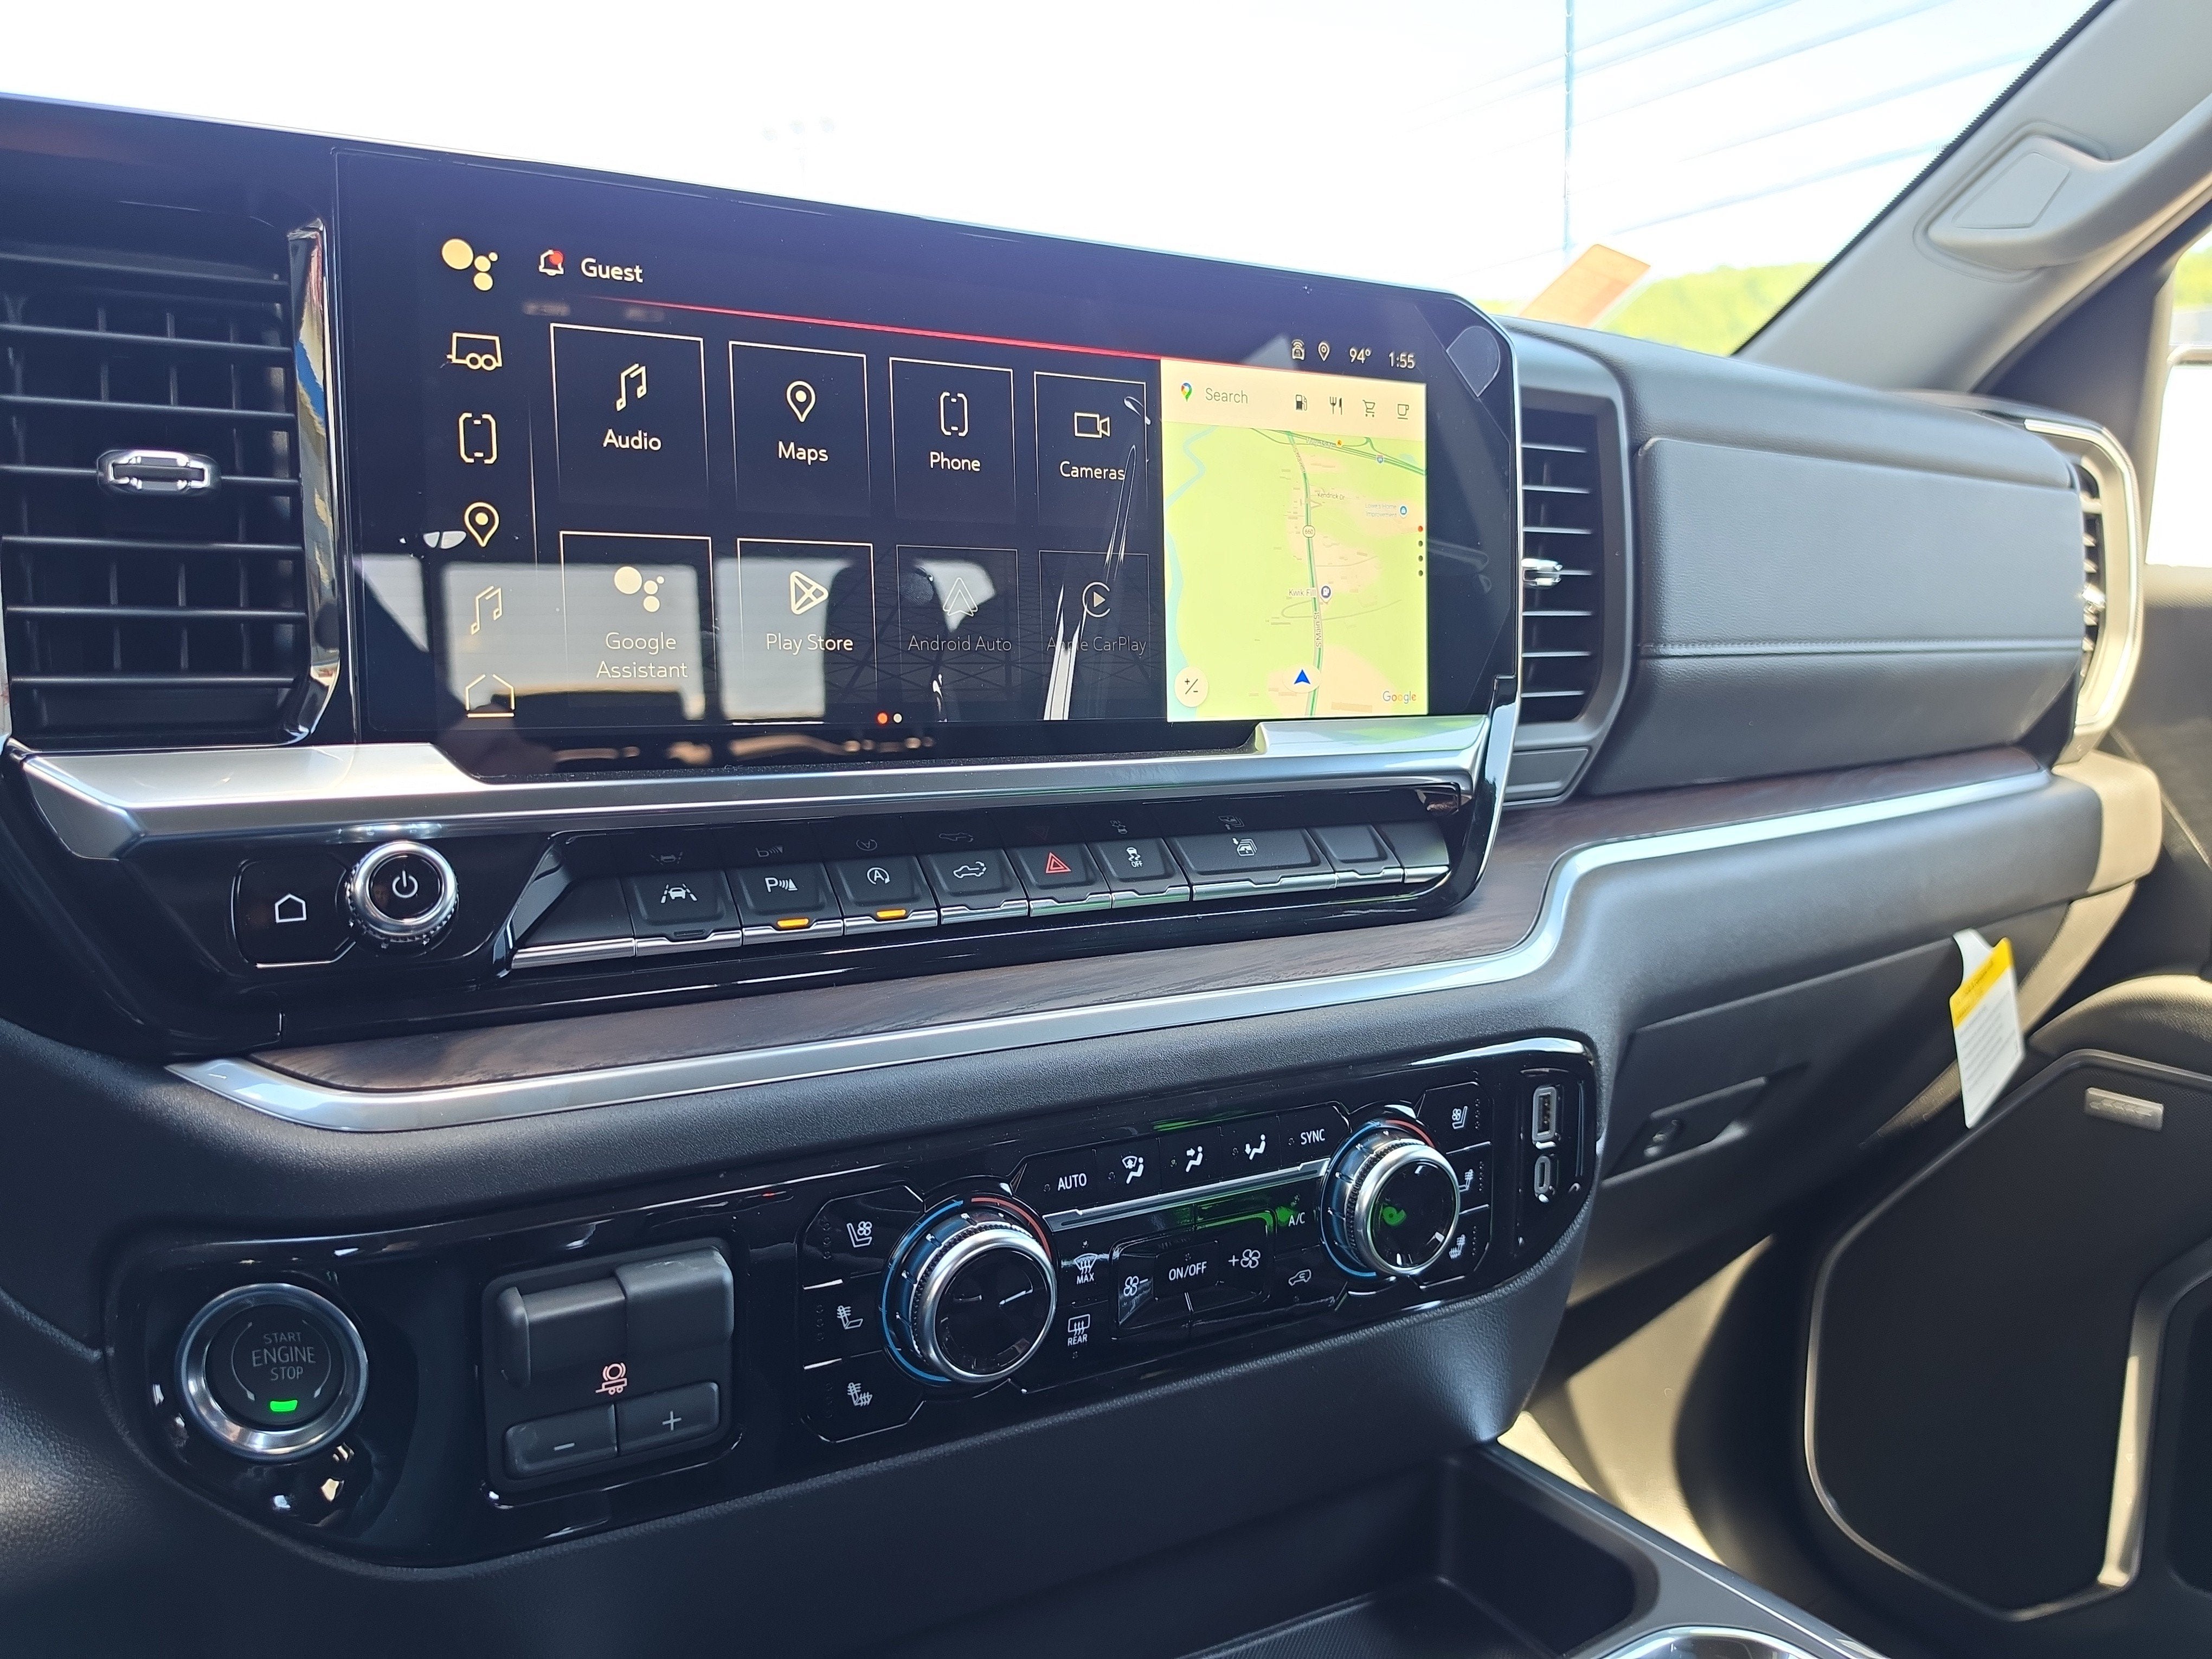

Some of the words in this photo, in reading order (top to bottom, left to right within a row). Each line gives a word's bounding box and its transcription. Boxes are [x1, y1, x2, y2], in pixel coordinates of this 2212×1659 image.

[580, 258, 644, 283] Guest
[1388, 351, 1416, 369] 1:55
[1205, 387, 1249, 404] Search
[602, 429, 662, 451] Audio
[777, 441, 829, 466] Maps
[929, 451, 981, 472] Phone
[1059, 461, 1126, 481] Cameras
[1306, 588, 1316, 596] Fill
[605, 632, 677, 654] Google
[766, 633, 803, 655] Play
[807, 634, 853, 652] Store
[908, 635, 972, 652] Android
[975, 636, 1012, 652] Auto
[1093, 635, 1147, 655] CarPlay
[596, 661, 689, 679] Assistant
[1382, 690, 1417, 704] Google
[1300, 1129, 1326, 1145] SYNC
[1057, 1173, 1087, 1191] AUTO
[1288, 1212, 1306, 1226] A/C
[1076, 1272, 1095, 1285] MAX
[1168, 1261, 1208, 1281] ON/OFF
[263, 1332, 302, 1344] START
[1067, 1333, 1088, 1347] REAR
[251, 1346, 317, 1368] ENGINE
[271, 1366, 304, 1381] STOP
